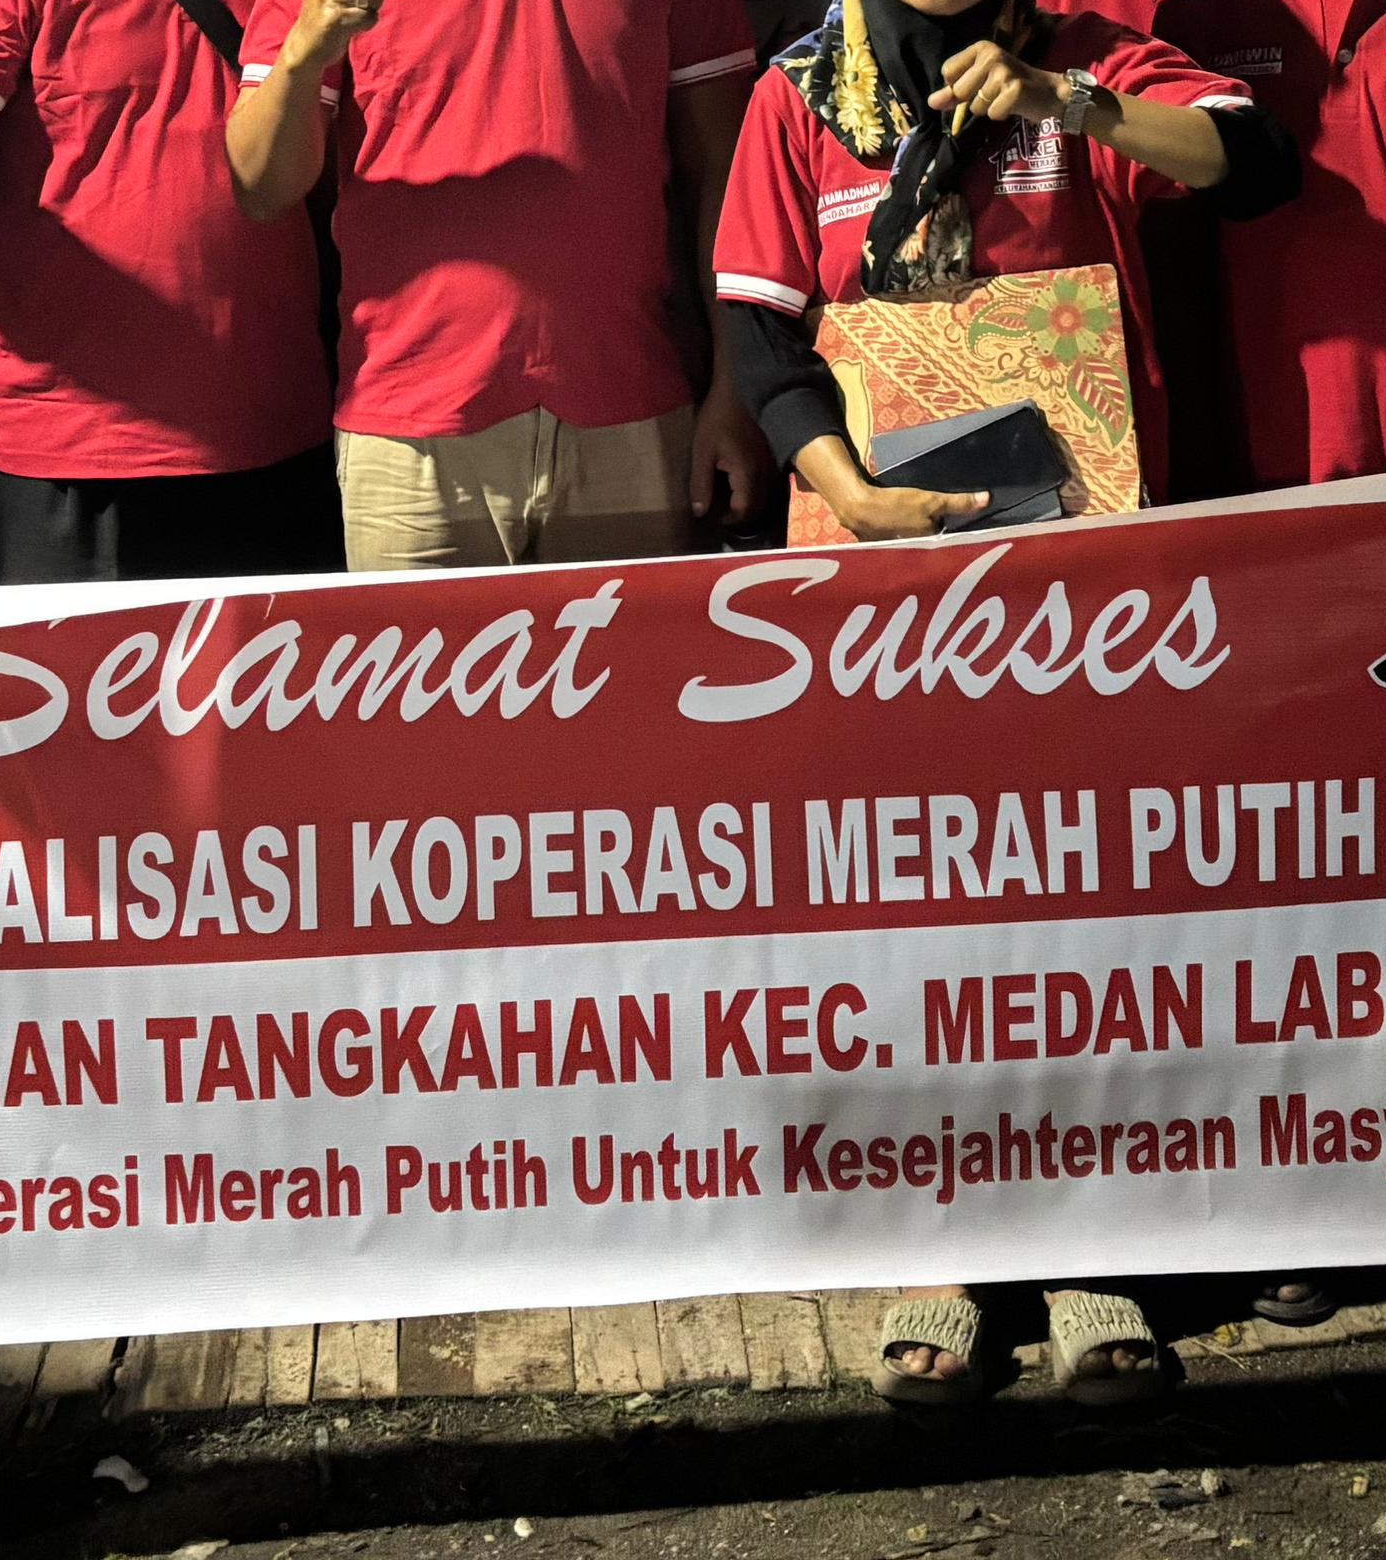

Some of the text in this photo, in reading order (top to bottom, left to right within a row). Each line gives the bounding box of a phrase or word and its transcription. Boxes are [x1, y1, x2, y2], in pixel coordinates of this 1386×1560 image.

[678, 542, 1231, 722] Sukses
[353, 800, 773, 929] KOPERASI
[805, 789, 1099, 906] MERAH
[1129, 777, 1377, 889] PUTIH
[145, 992, 672, 1105] TANGKAHAN
[703, 982, 894, 1080] KEC.
[923, 962, 1204, 1067] MEDAN
[164, 1147, 363, 1226] Merah
[385, 1139, 549, 1216] Putih
[571, 1127, 761, 1205] Untuk
[782, 1110, 1237, 1206] Kesejahteraan
